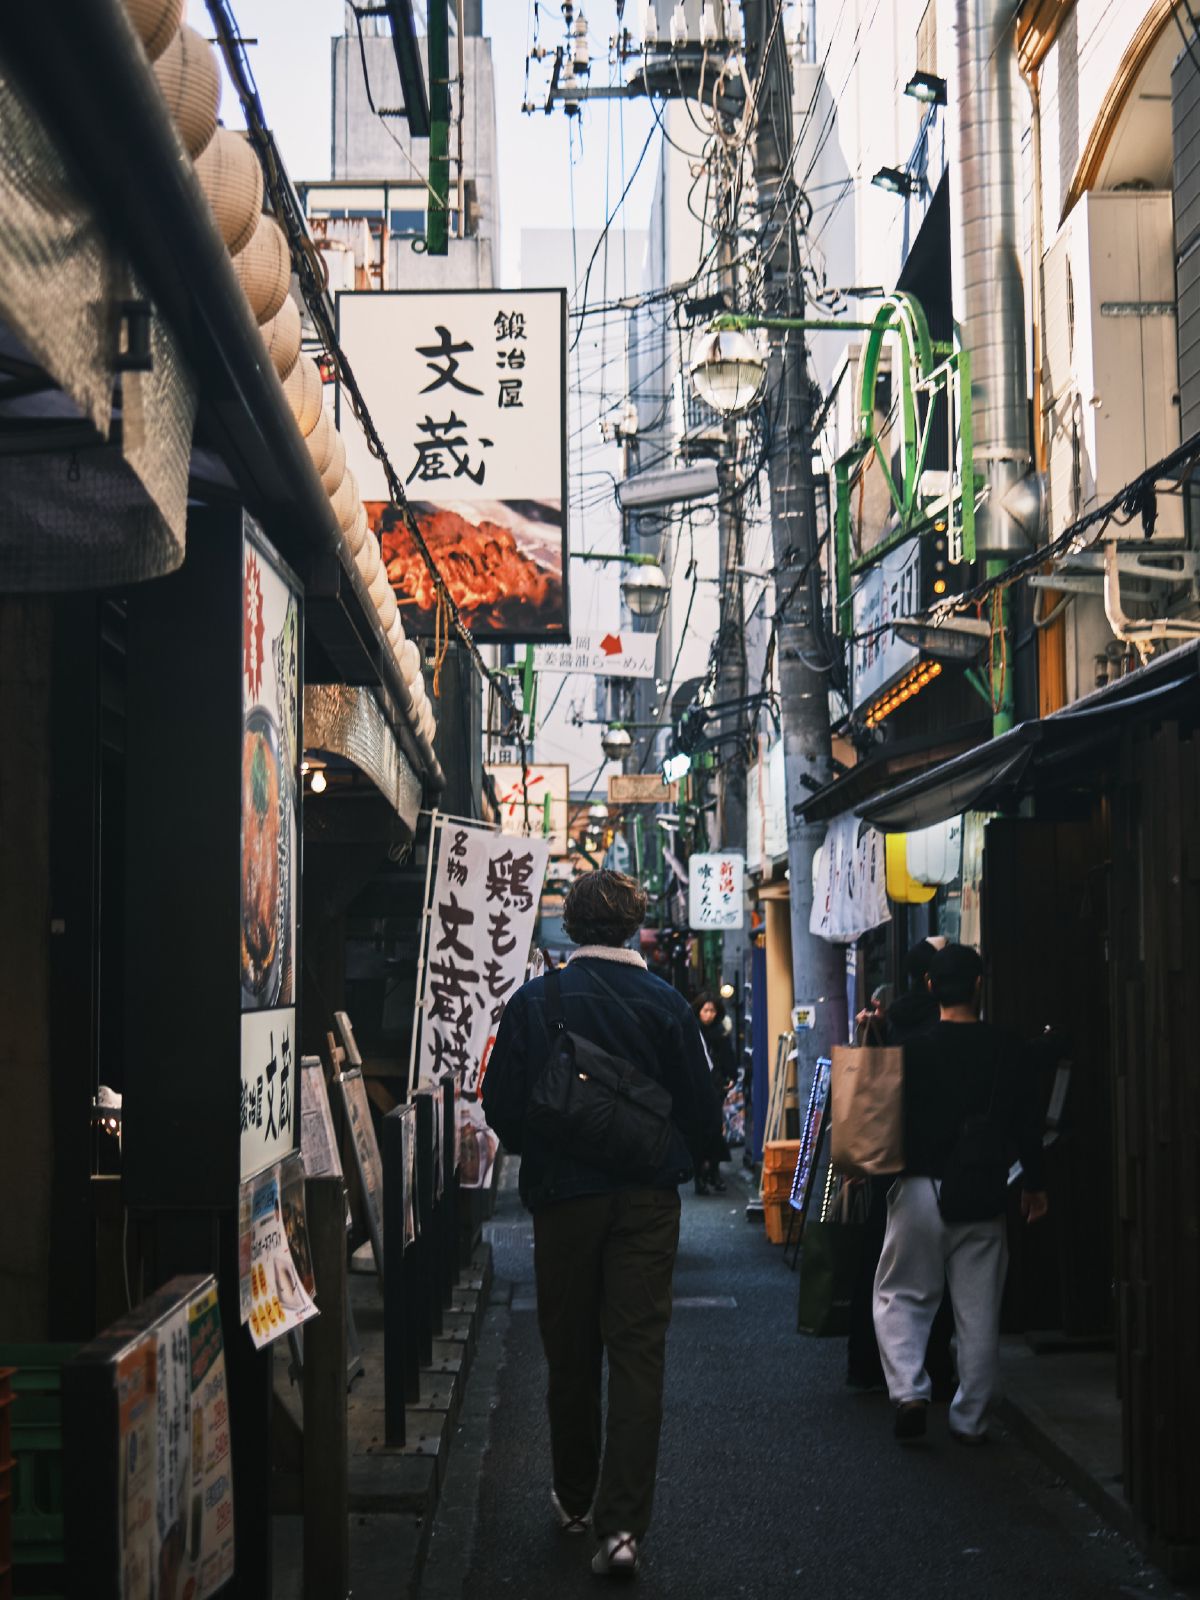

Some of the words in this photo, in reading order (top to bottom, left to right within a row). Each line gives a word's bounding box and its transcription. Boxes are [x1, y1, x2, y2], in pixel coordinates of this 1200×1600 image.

[494, 310, 528, 409] 鍛冶屋
[406, 326, 495, 487] 文蔵
[531, 651, 653, 673] 姜醤油らーめん
[446, 830, 469, 887] 名物
